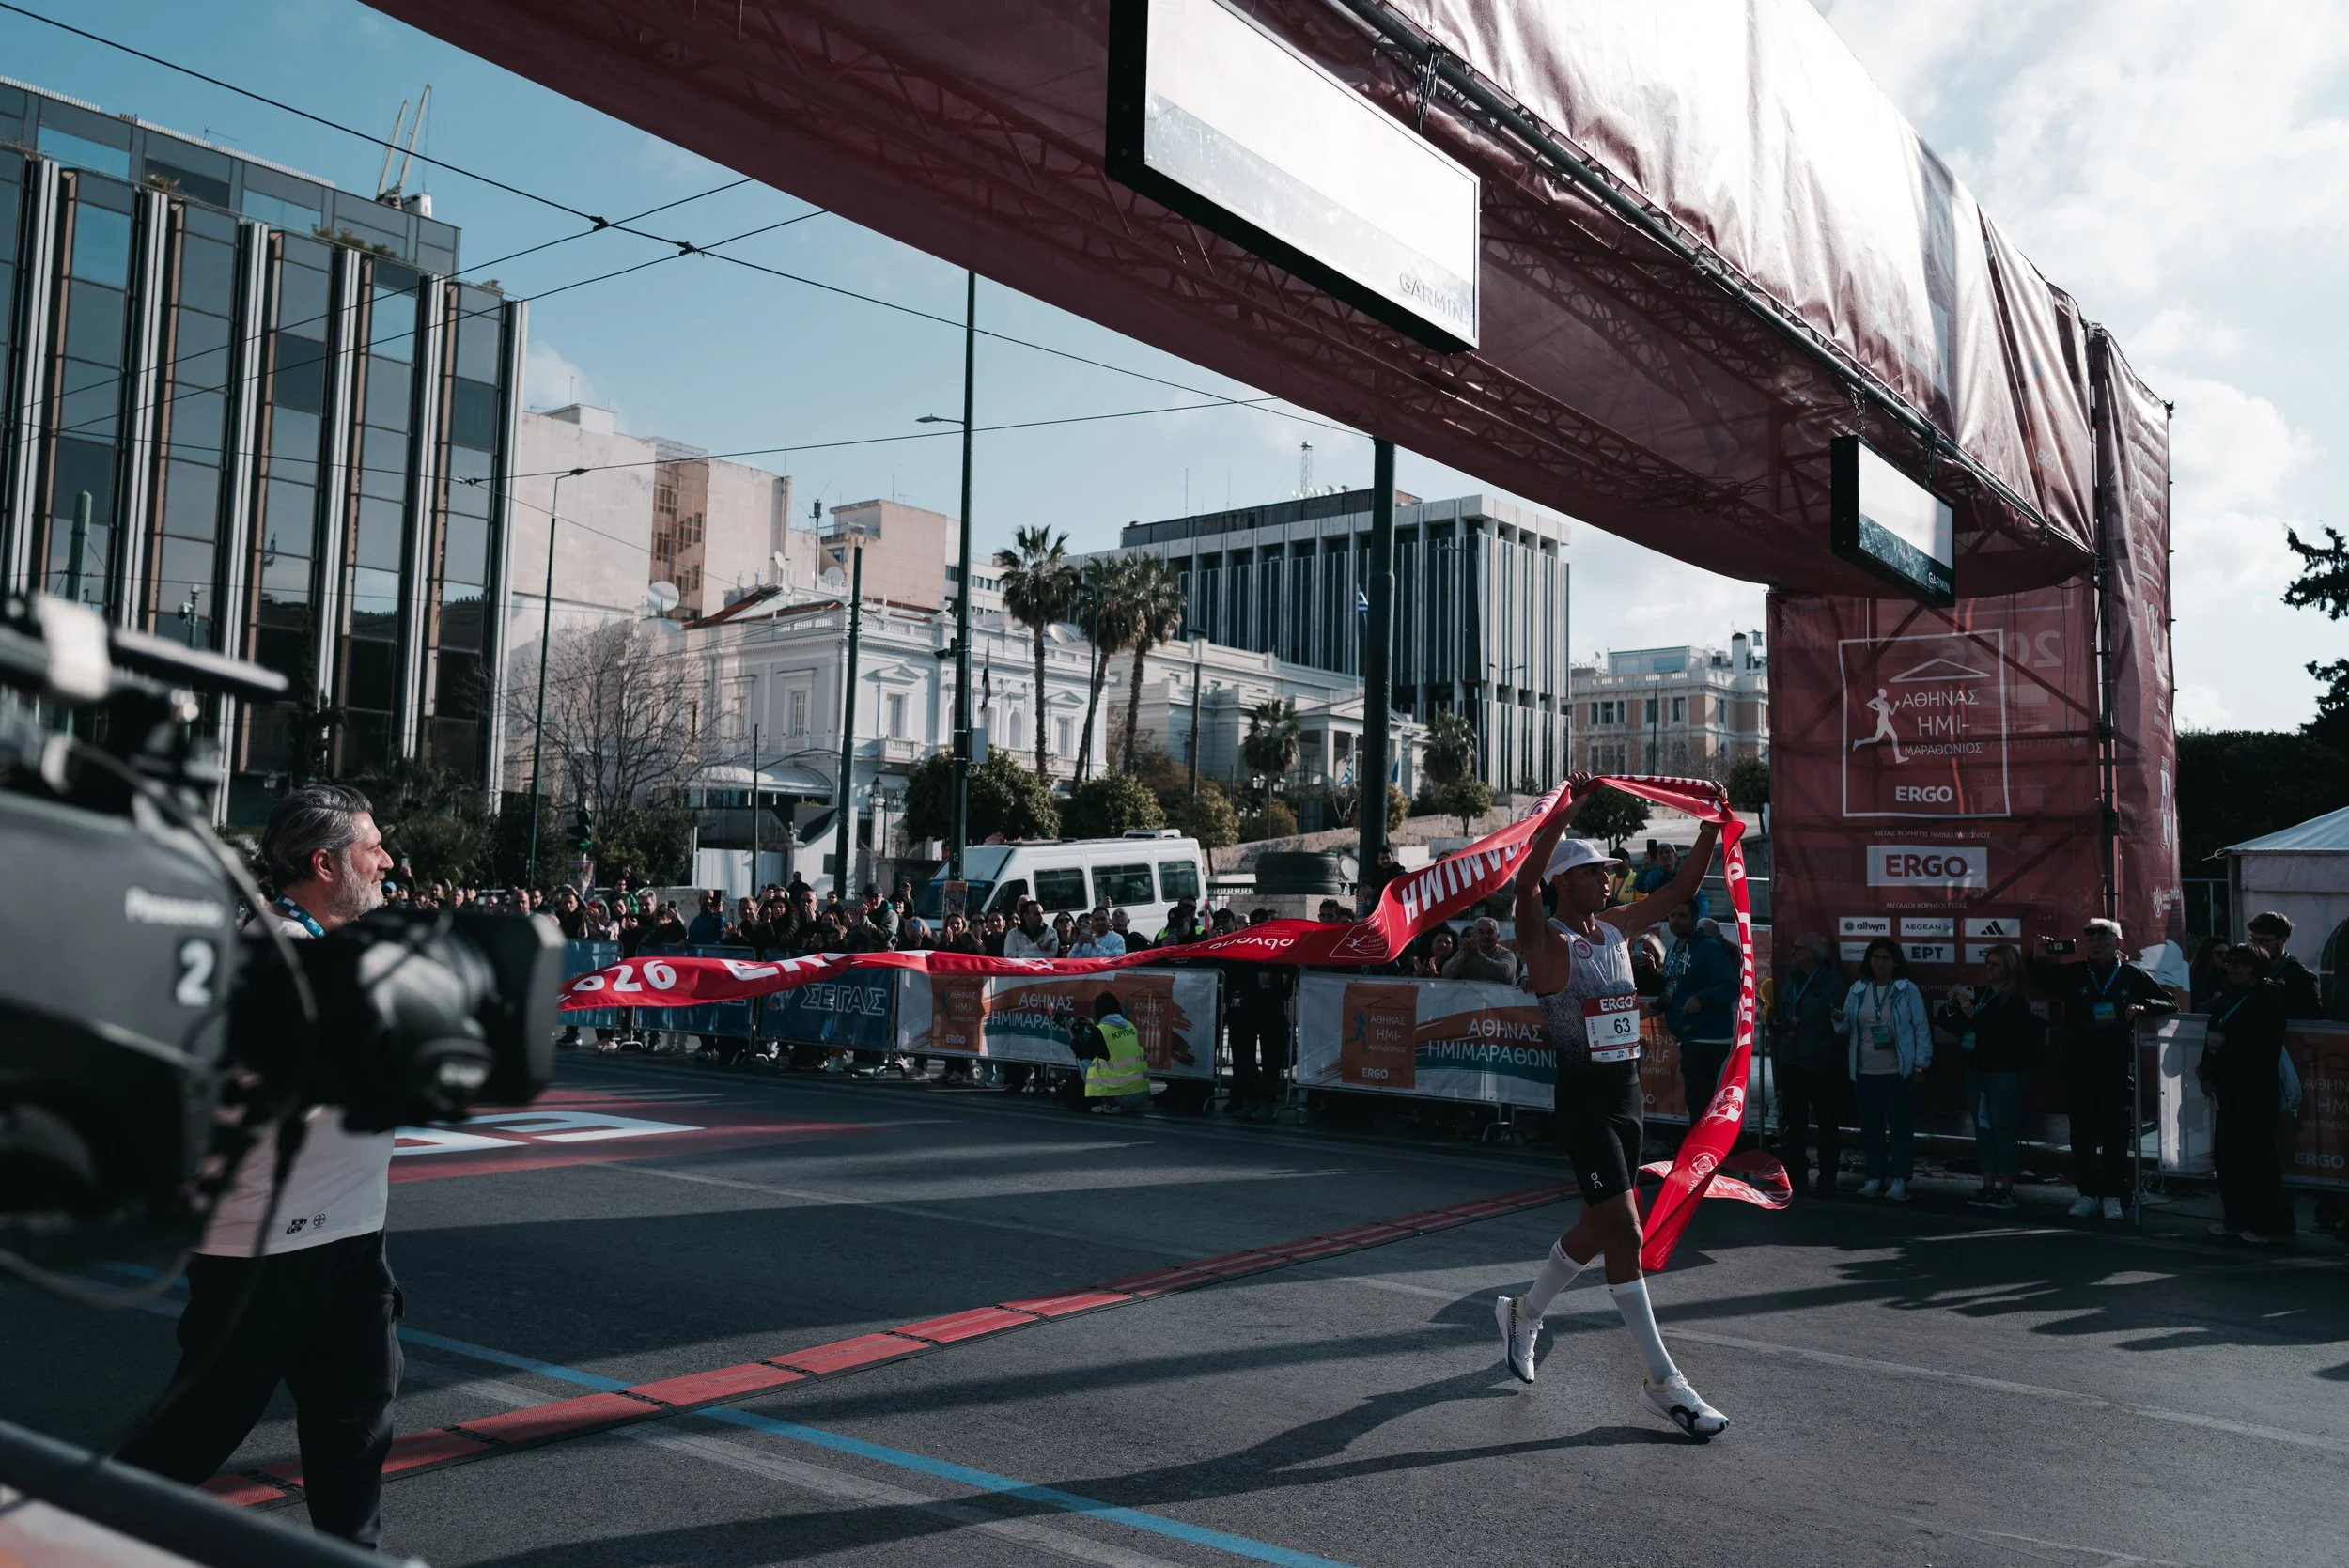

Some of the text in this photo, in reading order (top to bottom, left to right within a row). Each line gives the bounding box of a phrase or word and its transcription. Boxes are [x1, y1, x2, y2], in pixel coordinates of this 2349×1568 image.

[1399, 272, 1465, 323] GARMIN
[1928, 572, 1952, 595] GARMIN
[1901, 689, 1980, 708] ΑΘΗΝΑΣ
[1917, 715, 1970, 737] ΗΜΙ-
[1904, 741, 1983, 757] ΜΑΡΑΘΩΝΙΟΣ
[1894, 784, 1953, 804] ERGO
[1885, 853, 1968, 878] ERGO
[1857, 921, 1887, 932] allwyn
[1911, 946, 1944, 960] ΕΡΤ
[176, 939, 215, 1006] 2
[556, 959, 677, 1002] 026
[799, 982, 887, 1017] ΣΕΓΑΣ
[1018, 991, 1075, 1012] ΑΘΗΝΑΣ
[1599, 995, 1634, 1012] ERGO
[1369, 1015, 1406, 1026] ΑΘΗΝΑΣ
[1467, 1017, 1544, 1043] ΑΘΗΝΑΣ
[1614, 1017, 1631, 1034] 63
[945, 1033, 966, 1045] ERGO
[1377, 1029, 1402, 1042] ΗΜΙ-
[1639, 1033, 1675, 1046] THENS
[1361, 1067, 1389, 1079] ERGO
[2294, 1151, 2345, 1170] ERGO
